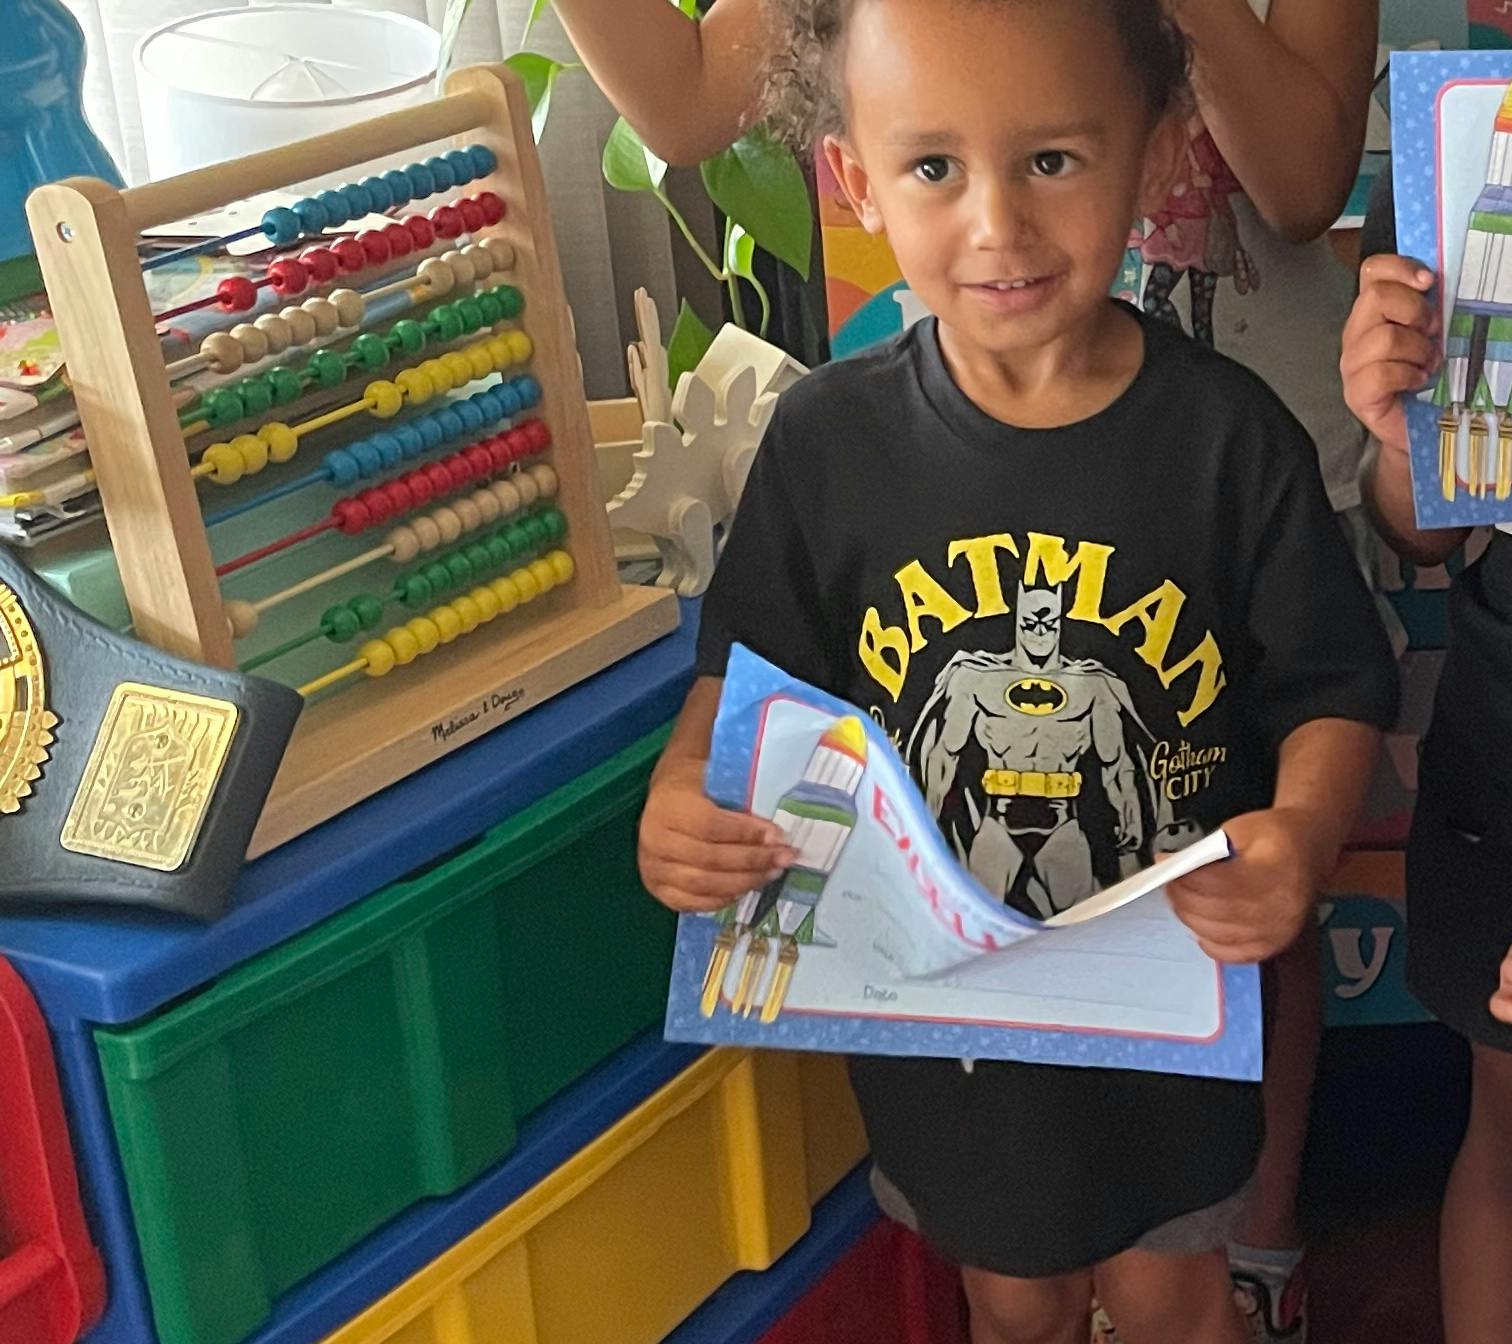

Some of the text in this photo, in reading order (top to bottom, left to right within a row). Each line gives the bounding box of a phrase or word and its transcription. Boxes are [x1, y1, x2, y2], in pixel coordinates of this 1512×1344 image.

[858, 531, 1228, 728] BATMAN
[1150, 739, 1227, 781] Gotham
[1166, 765, 1217, 801] CITY
[863, 984, 899, 1002] Date
